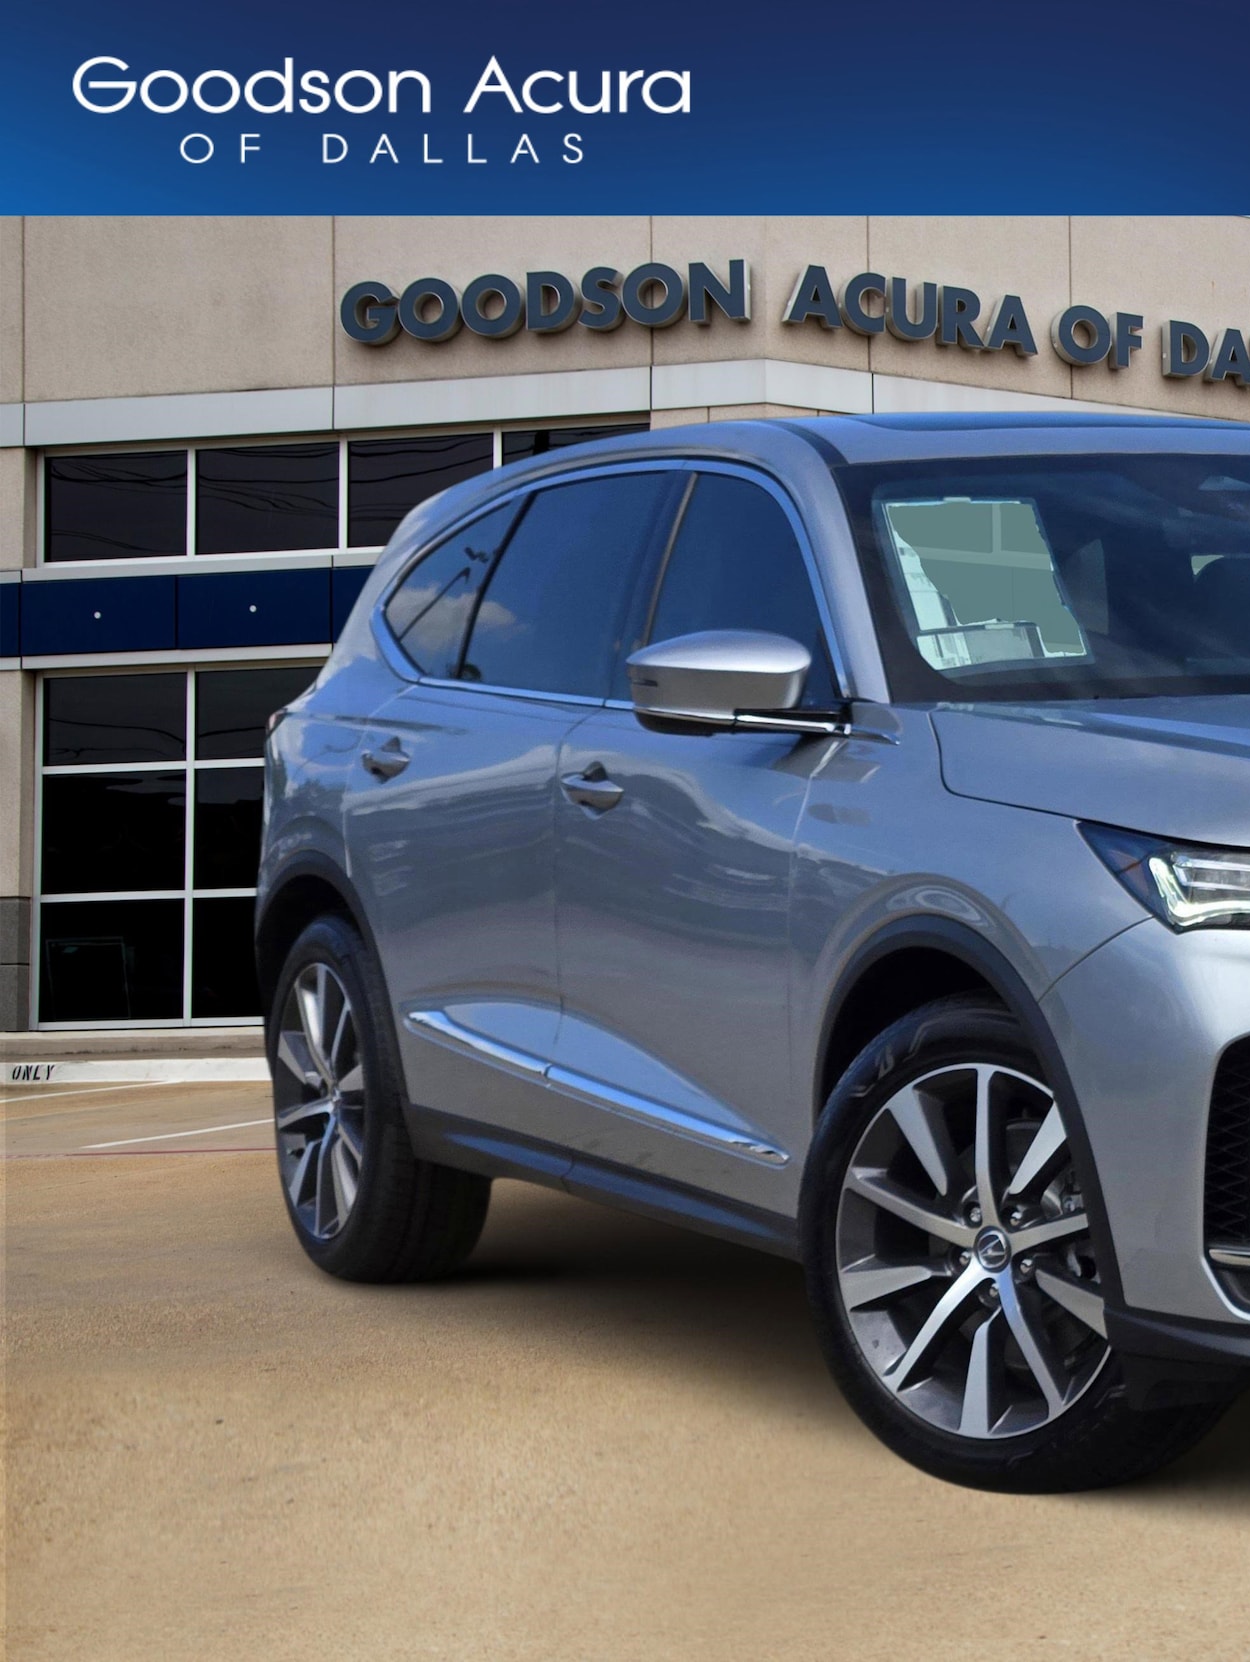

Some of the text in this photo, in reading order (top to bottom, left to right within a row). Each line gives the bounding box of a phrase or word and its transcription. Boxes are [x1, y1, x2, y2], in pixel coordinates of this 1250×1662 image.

[340, 258, 752, 347] GOODSON
[782, 264, 1039, 358] ACURA
[1050, 304, 1145, 371] OF
[12, 1064, 55, 1081] ONLY
